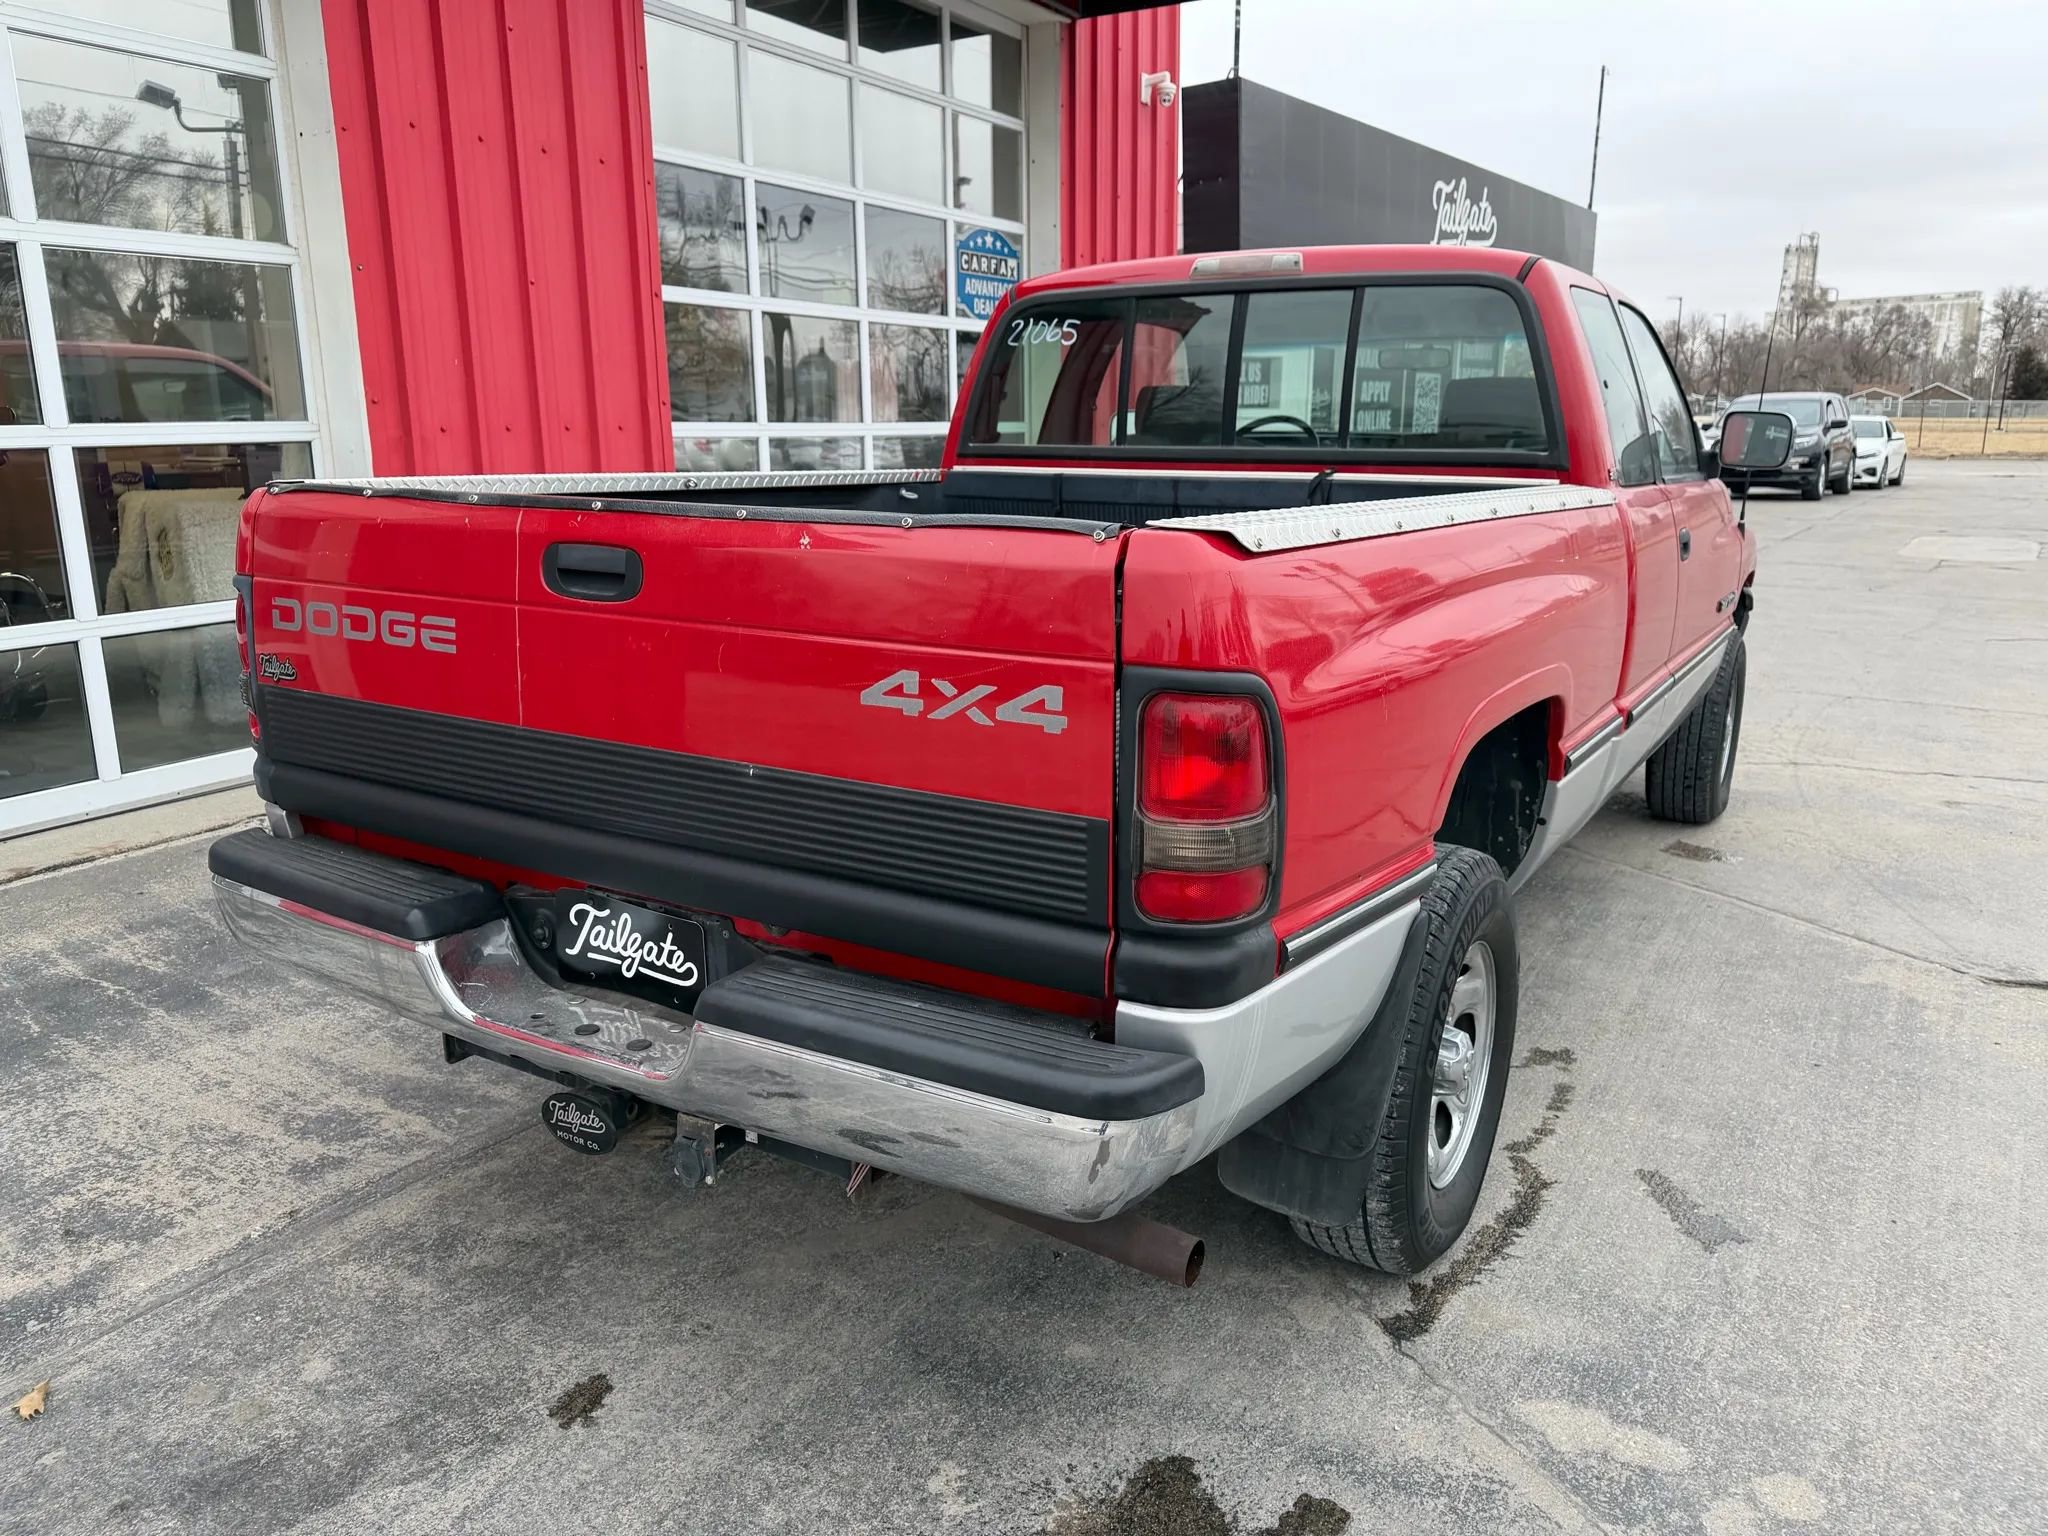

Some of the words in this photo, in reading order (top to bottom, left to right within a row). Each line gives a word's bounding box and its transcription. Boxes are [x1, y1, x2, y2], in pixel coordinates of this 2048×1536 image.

[1430, 177, 1497, 246] Tailgate
[961, 252, 1017, 279] CARFAX
[1007, 317, 1081, 346] 21065
[1360, 380, 1391, 403] APPLY
[1356, 409, 1391, 431] ONLINE
[272, 597, 456, 654] DODGE
[259, 654, 296, 682] Tailgate
[565, 903, 698, 987] Tailgate
[549, 1100, 606, 1134] Tailgate
[556, 1130, 585, 1146] MOTOR
[586, 1140, 601, 1151] CO.
